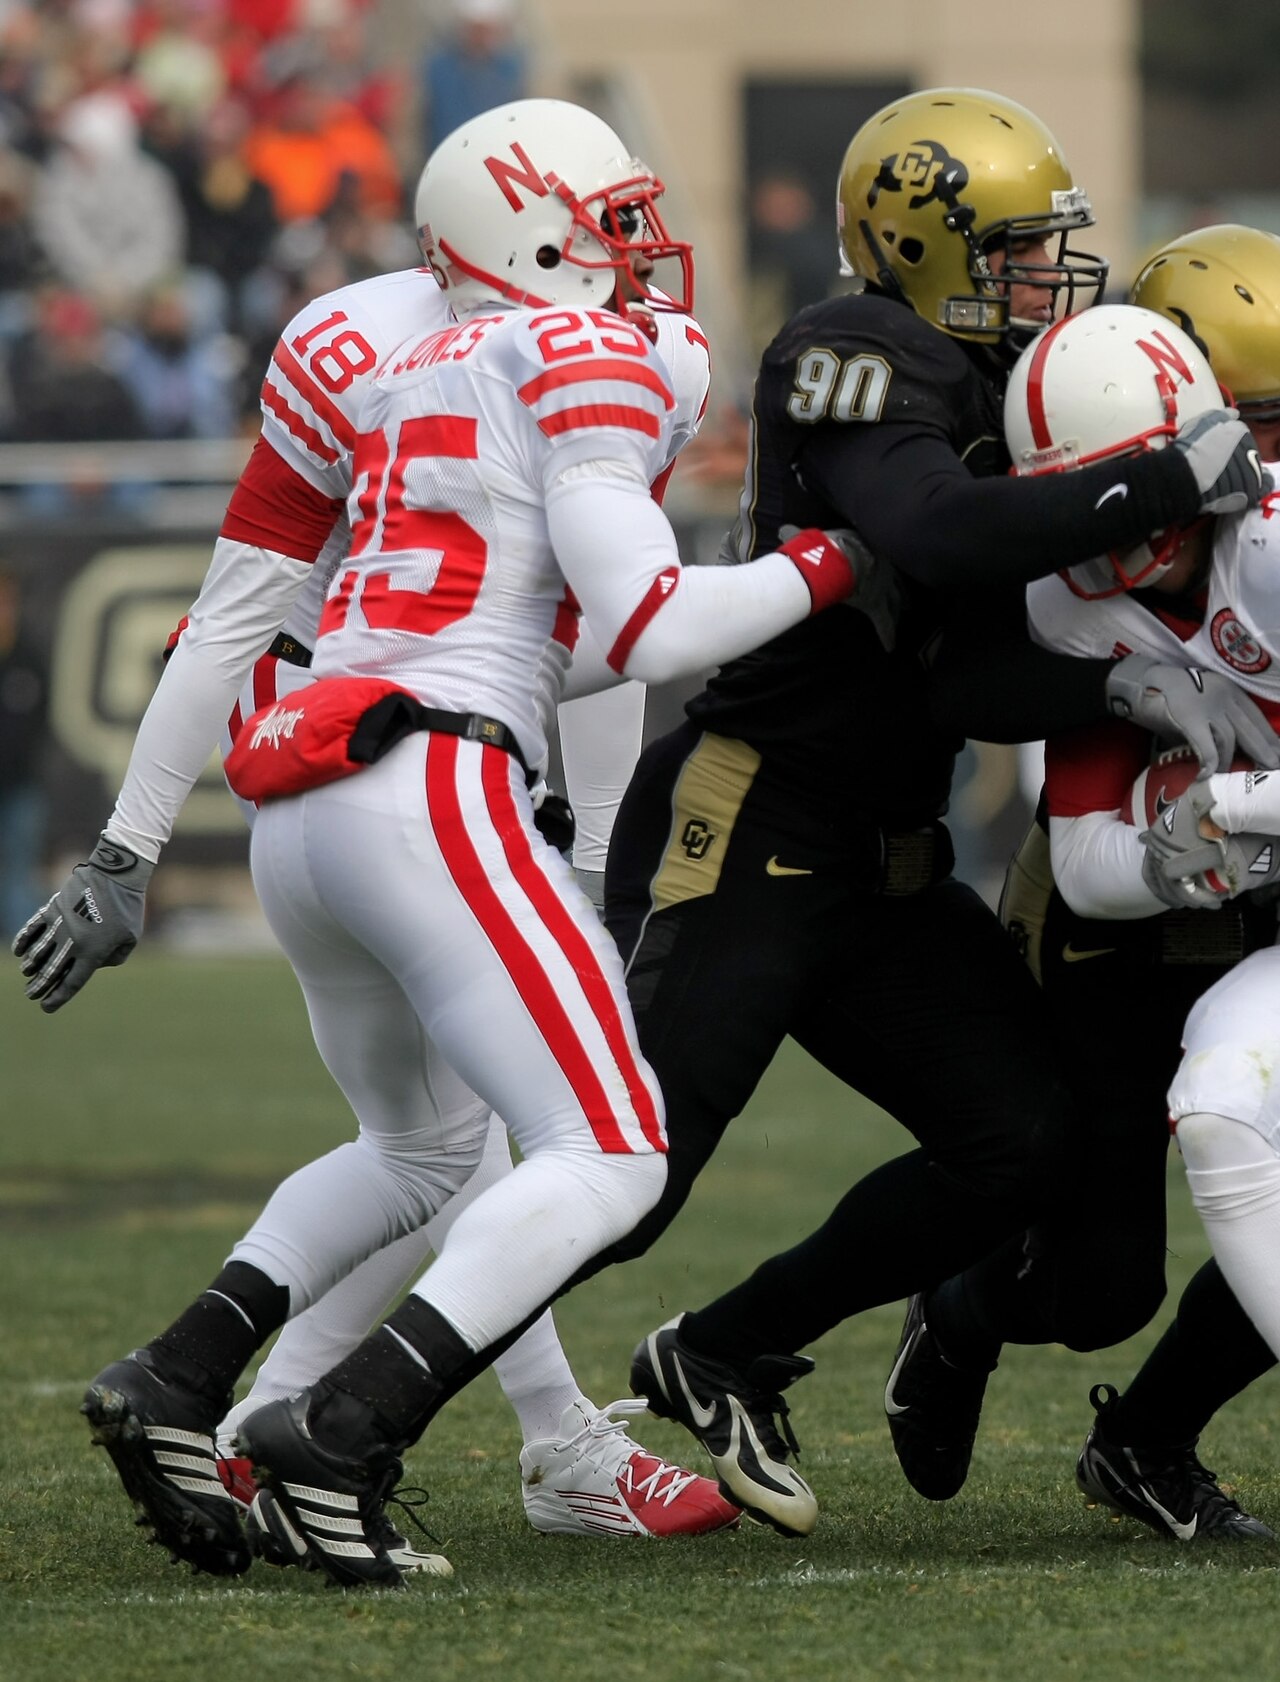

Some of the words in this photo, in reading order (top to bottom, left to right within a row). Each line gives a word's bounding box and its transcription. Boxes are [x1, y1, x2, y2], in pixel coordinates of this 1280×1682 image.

[483, 141, 549, 213] N
[291, 310, 377, 394] 18
[528, 311, 649, 364] 25
[1135, 330, 1195, 394] N
[788, 347, 892, 424] 90
[84, 887, 103, 924] adidas
